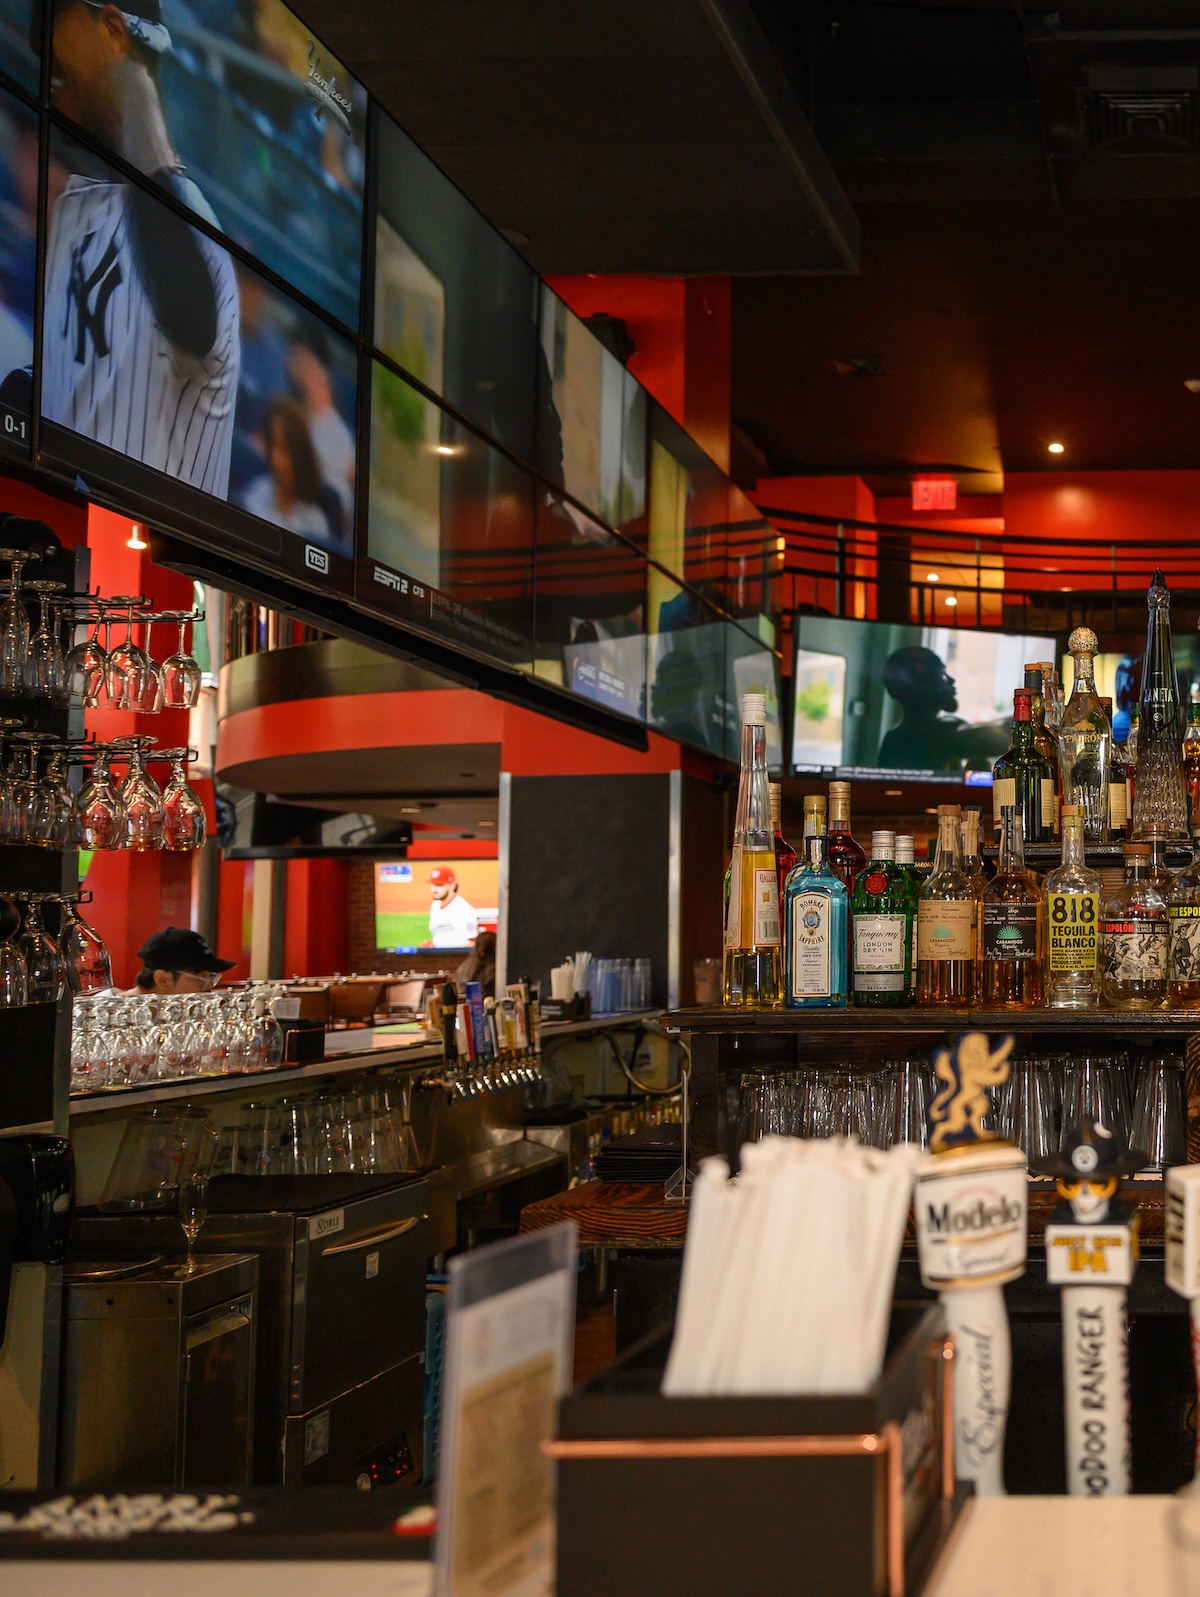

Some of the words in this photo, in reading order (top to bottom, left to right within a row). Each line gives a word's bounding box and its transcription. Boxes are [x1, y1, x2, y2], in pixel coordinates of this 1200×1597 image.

[306, 38, 352, 113] Yankees
[4, 414, 26, 439] 0-1
[309, 551, 325, 568] YES
[373, 566, 409, 594] ESPN2
[412, 585, 425, 599] CFB
[799, 899, 825, 912] BOMBAY
[1052, 896, 1096, 924] 818
[798, 932, 827, 945] SAPPHIRE
[858, 928, 899, 940] Tanqueray
[1051, 925, 1096, 937] TEQUILA
[1051, 937, 1096, 949] BLANCO
[926, 1194, 1022, 1235] Modelo
[1067, 1247, 1108, 1273] IPA
[1078, 1304, 1105, 1411] RANGER
[1079, 1419, 1108, 1497] ODOO
